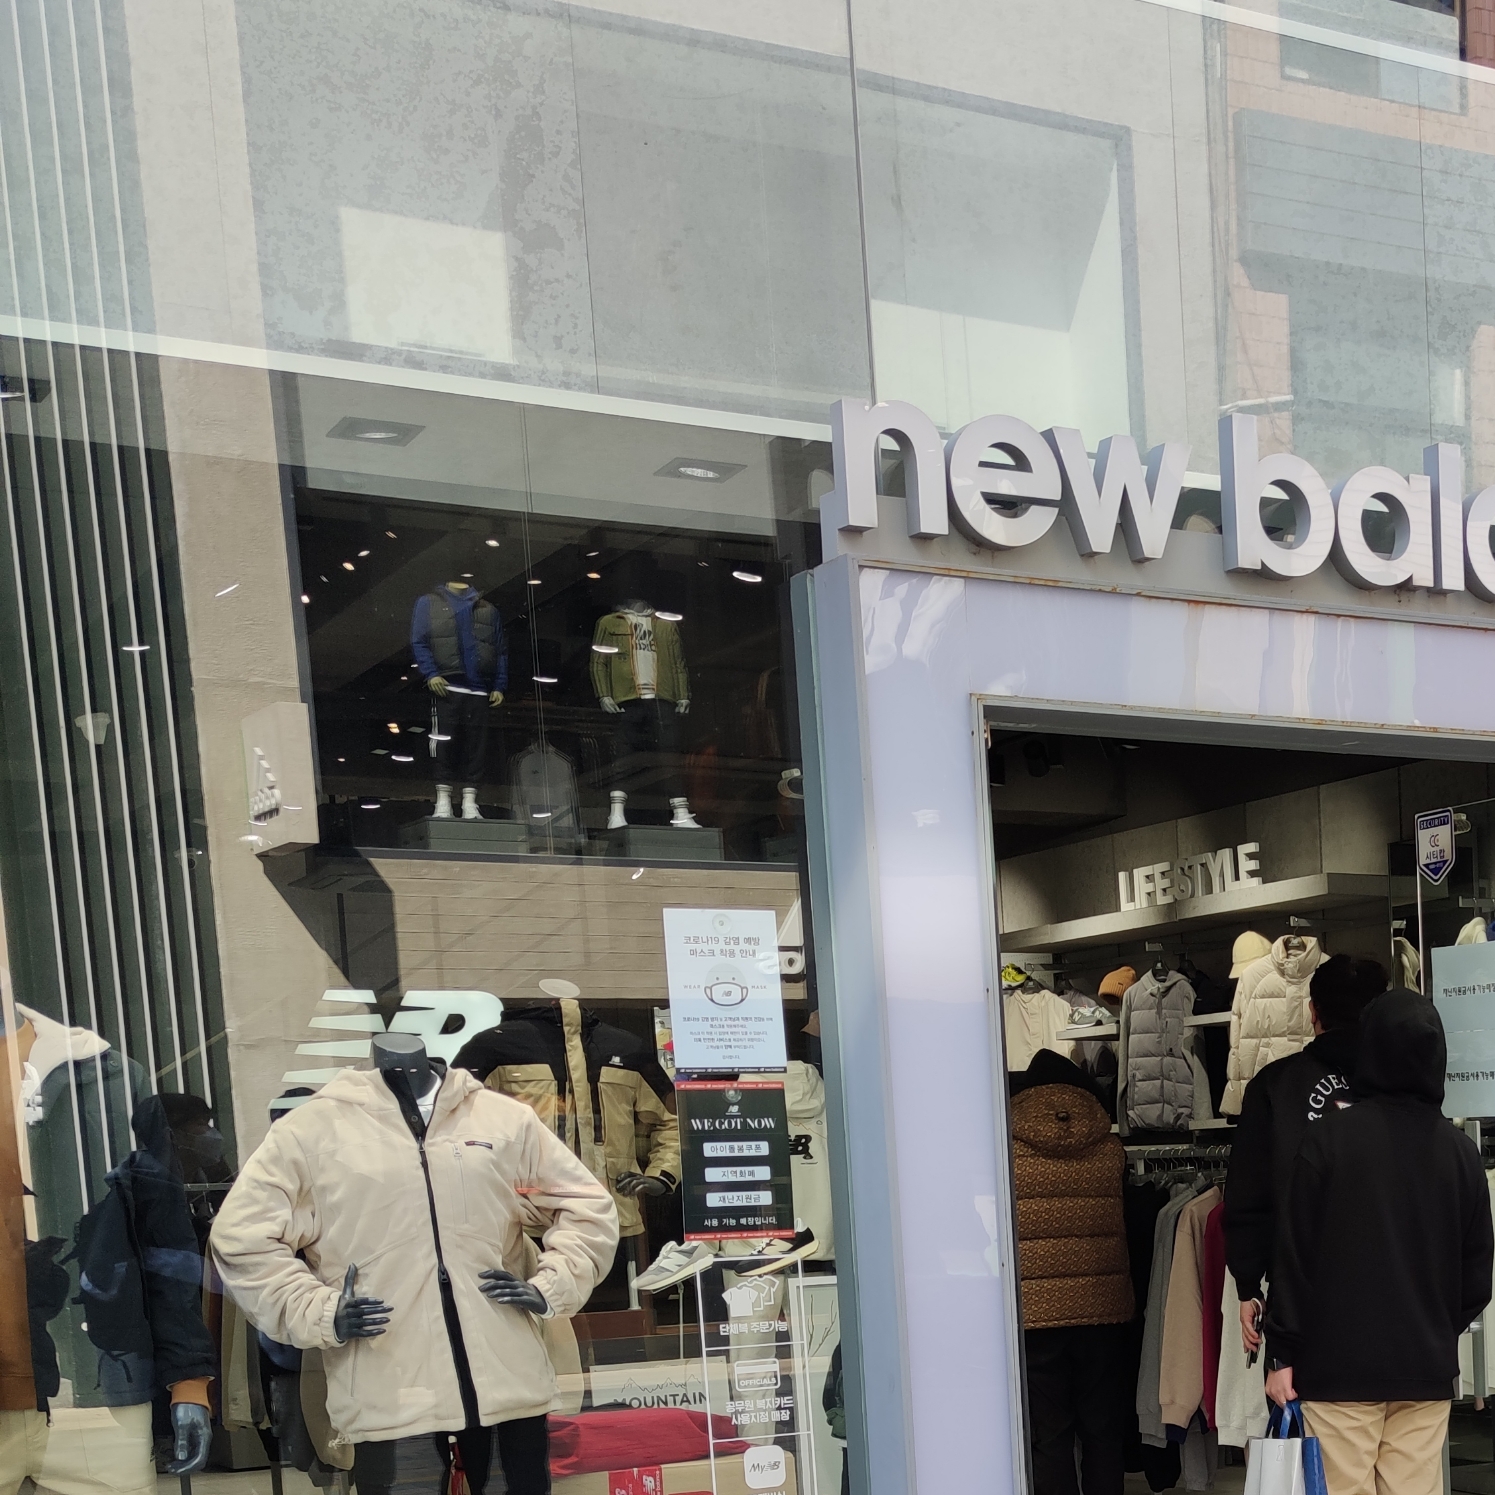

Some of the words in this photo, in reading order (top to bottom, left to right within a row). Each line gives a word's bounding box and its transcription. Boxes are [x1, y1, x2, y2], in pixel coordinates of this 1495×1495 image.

[832, 396, 1191, 563] new
[1420, 816, 1448, 830] SECURITY
[1118, 842, 1263, 912] LIFESTYLE
[683, 936, 720, 946] 코로나19
[723, 936, 741, 946] 감염
[743, 937, 761, 946] 예방
[689, 949, 716, 958] 마스크
[719, 949, 736, 958] 착용
[739, 949, 757, 958] 안내
[690, 1119, 713, 1130] WE
[715, 1118, 743, 1130] GOT
[746, 1117, 777, 1129] NOW
[710, 1144, 763, 1154] 아이돌봄쿠폰
[718, 1194, 761, 1204] 재난지원금
[704, 1218, 718, 1227] 사용
[722, 1218, 736, 1227] 가능
[720, 1323, 748, 1335] 단체복
[750, 1320, 788, 1333] 주문가능
[740, 1377, 776, 1386] OFFICIALS
[725, 1400, 754, 1413] 공무원
[756, 1396, 794, 1410] 복지카드
[731, 1412, 769, 1425] 사용지정
[771, 1409, 790, 1422] 매장
